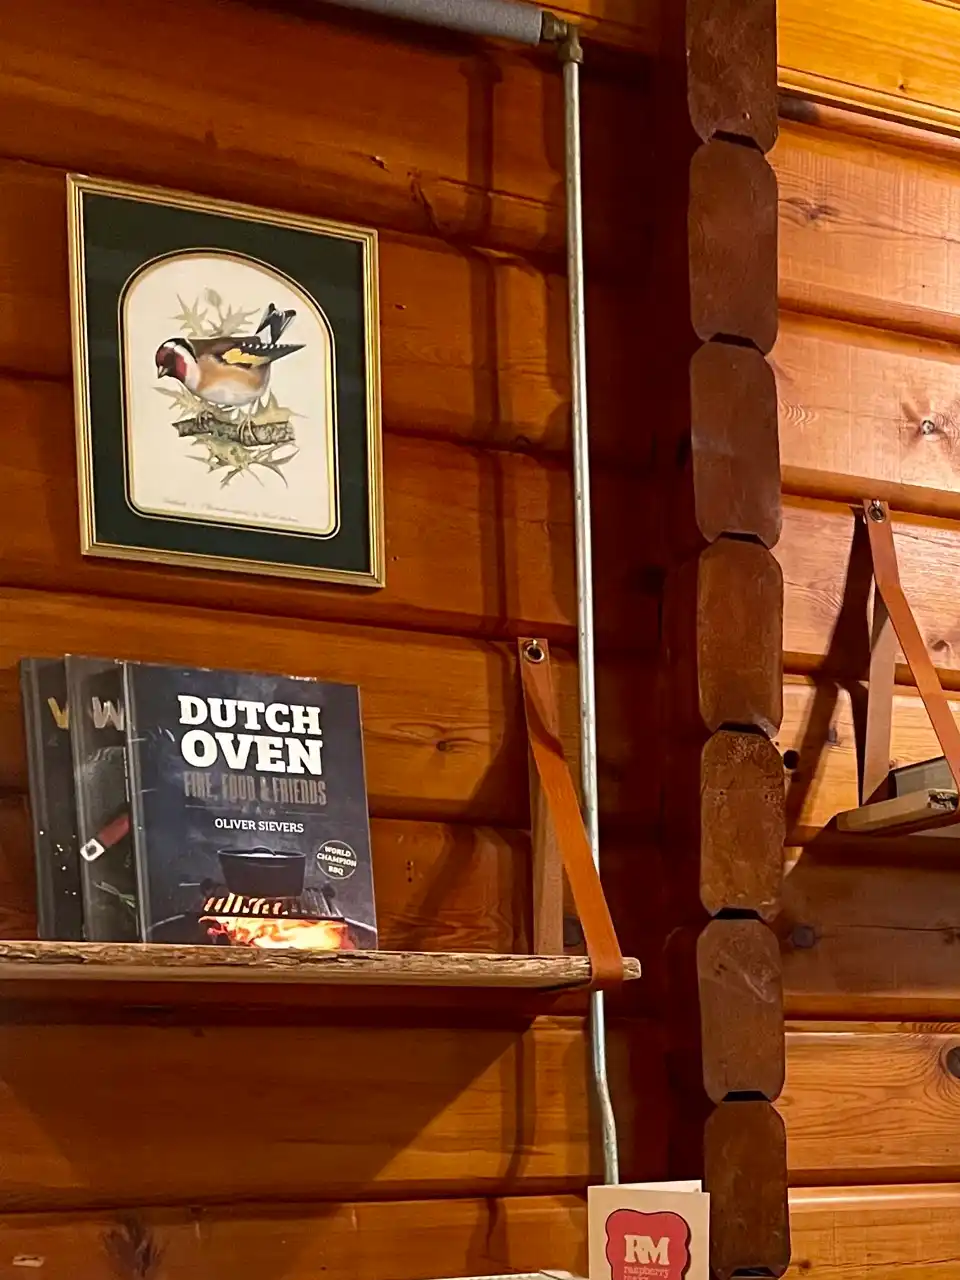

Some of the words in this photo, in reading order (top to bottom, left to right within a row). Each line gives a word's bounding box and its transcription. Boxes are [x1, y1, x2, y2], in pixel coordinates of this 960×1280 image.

[178, 694, 321, 736] DUTCH
[180, 729, 323, 775] OVEN
[221, 773, 257, 803] FOOD
[273, 777, 328, 806] FRIENDS
[214, 817, 257, 831] OLIVER
[258, 819, 305, 834] SIEVERS
[316, 852, 357, 867] CHAMPION
[324, 845, 352, 858] WORLD
[623, 1234, 670, 1266] RM
